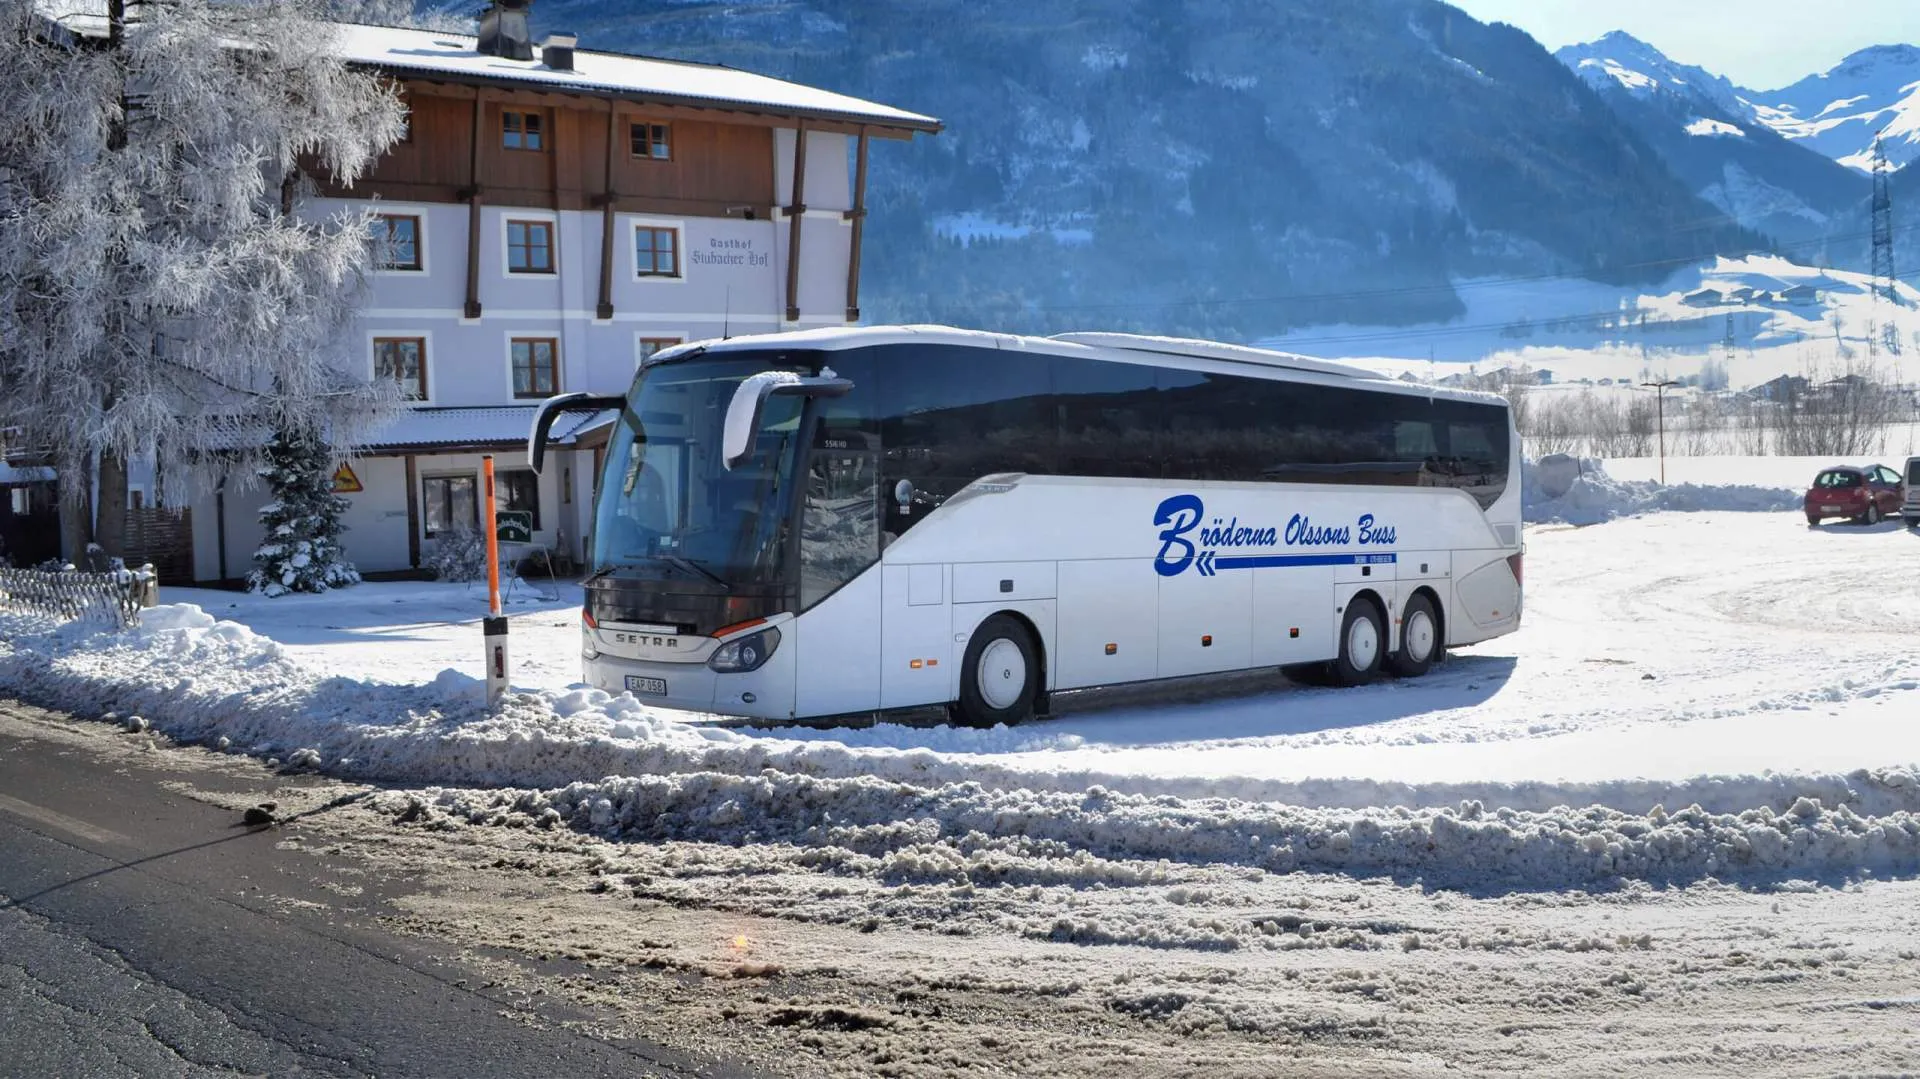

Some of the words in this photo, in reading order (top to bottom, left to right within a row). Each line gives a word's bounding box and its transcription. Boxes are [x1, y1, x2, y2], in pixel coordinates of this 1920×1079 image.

[1153, 494, 1277, 577] Bröderna
[1285, 513, 1351, 545] Olssons
[1358, 513, 1397, 545] Buss
[615, 633, 678, 648] SETRA
[631, 678, 645, 690] EAP
[647, 680, 663, 692] 058
